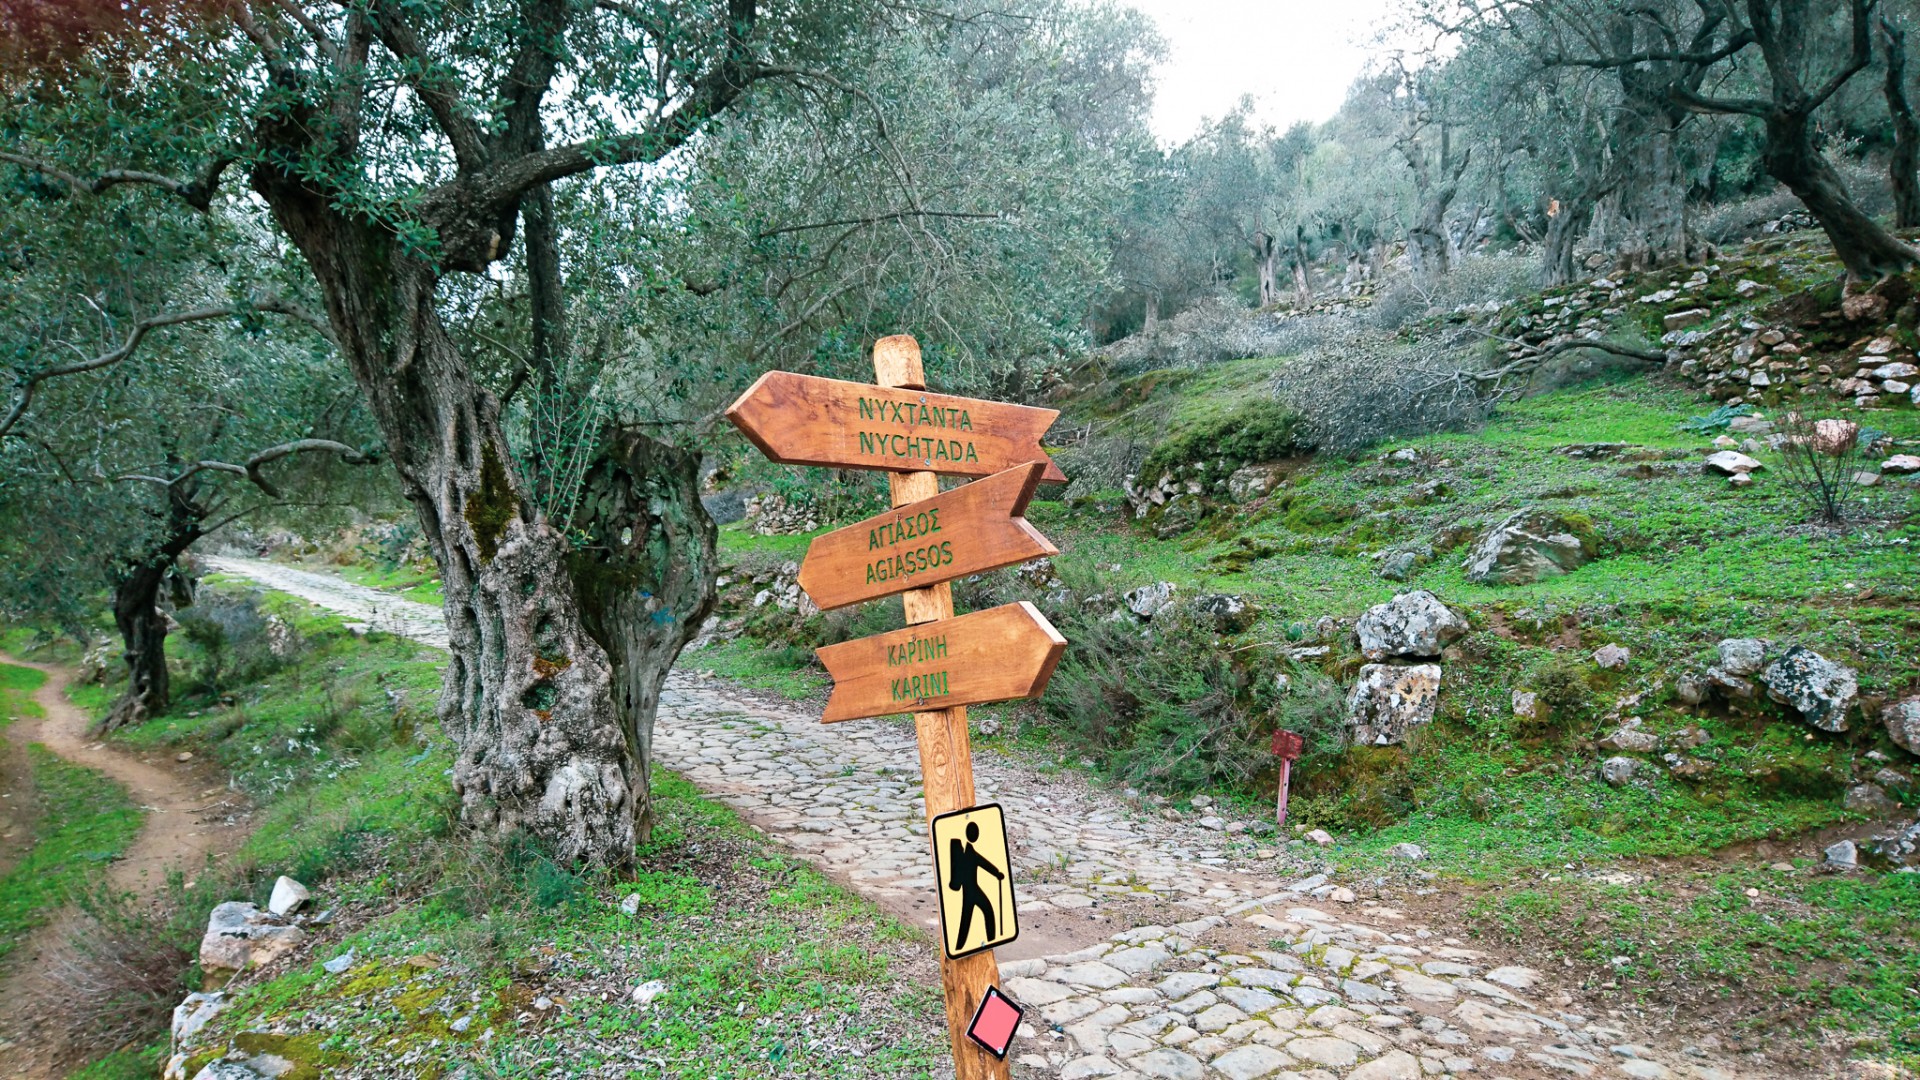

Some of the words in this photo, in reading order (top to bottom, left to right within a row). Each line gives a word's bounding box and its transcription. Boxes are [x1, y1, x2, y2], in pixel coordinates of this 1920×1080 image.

[859, 431, 979, 463] NYCHTADA
[869, 508, 941, 551] ΑΓΙΑΣΟΣ
[866, 540, 953, 584] AGIASSOS
[887, 634, 948, 667] ΚΑΡΙΝΗ
[891, 670, 949, 701] KARINI
